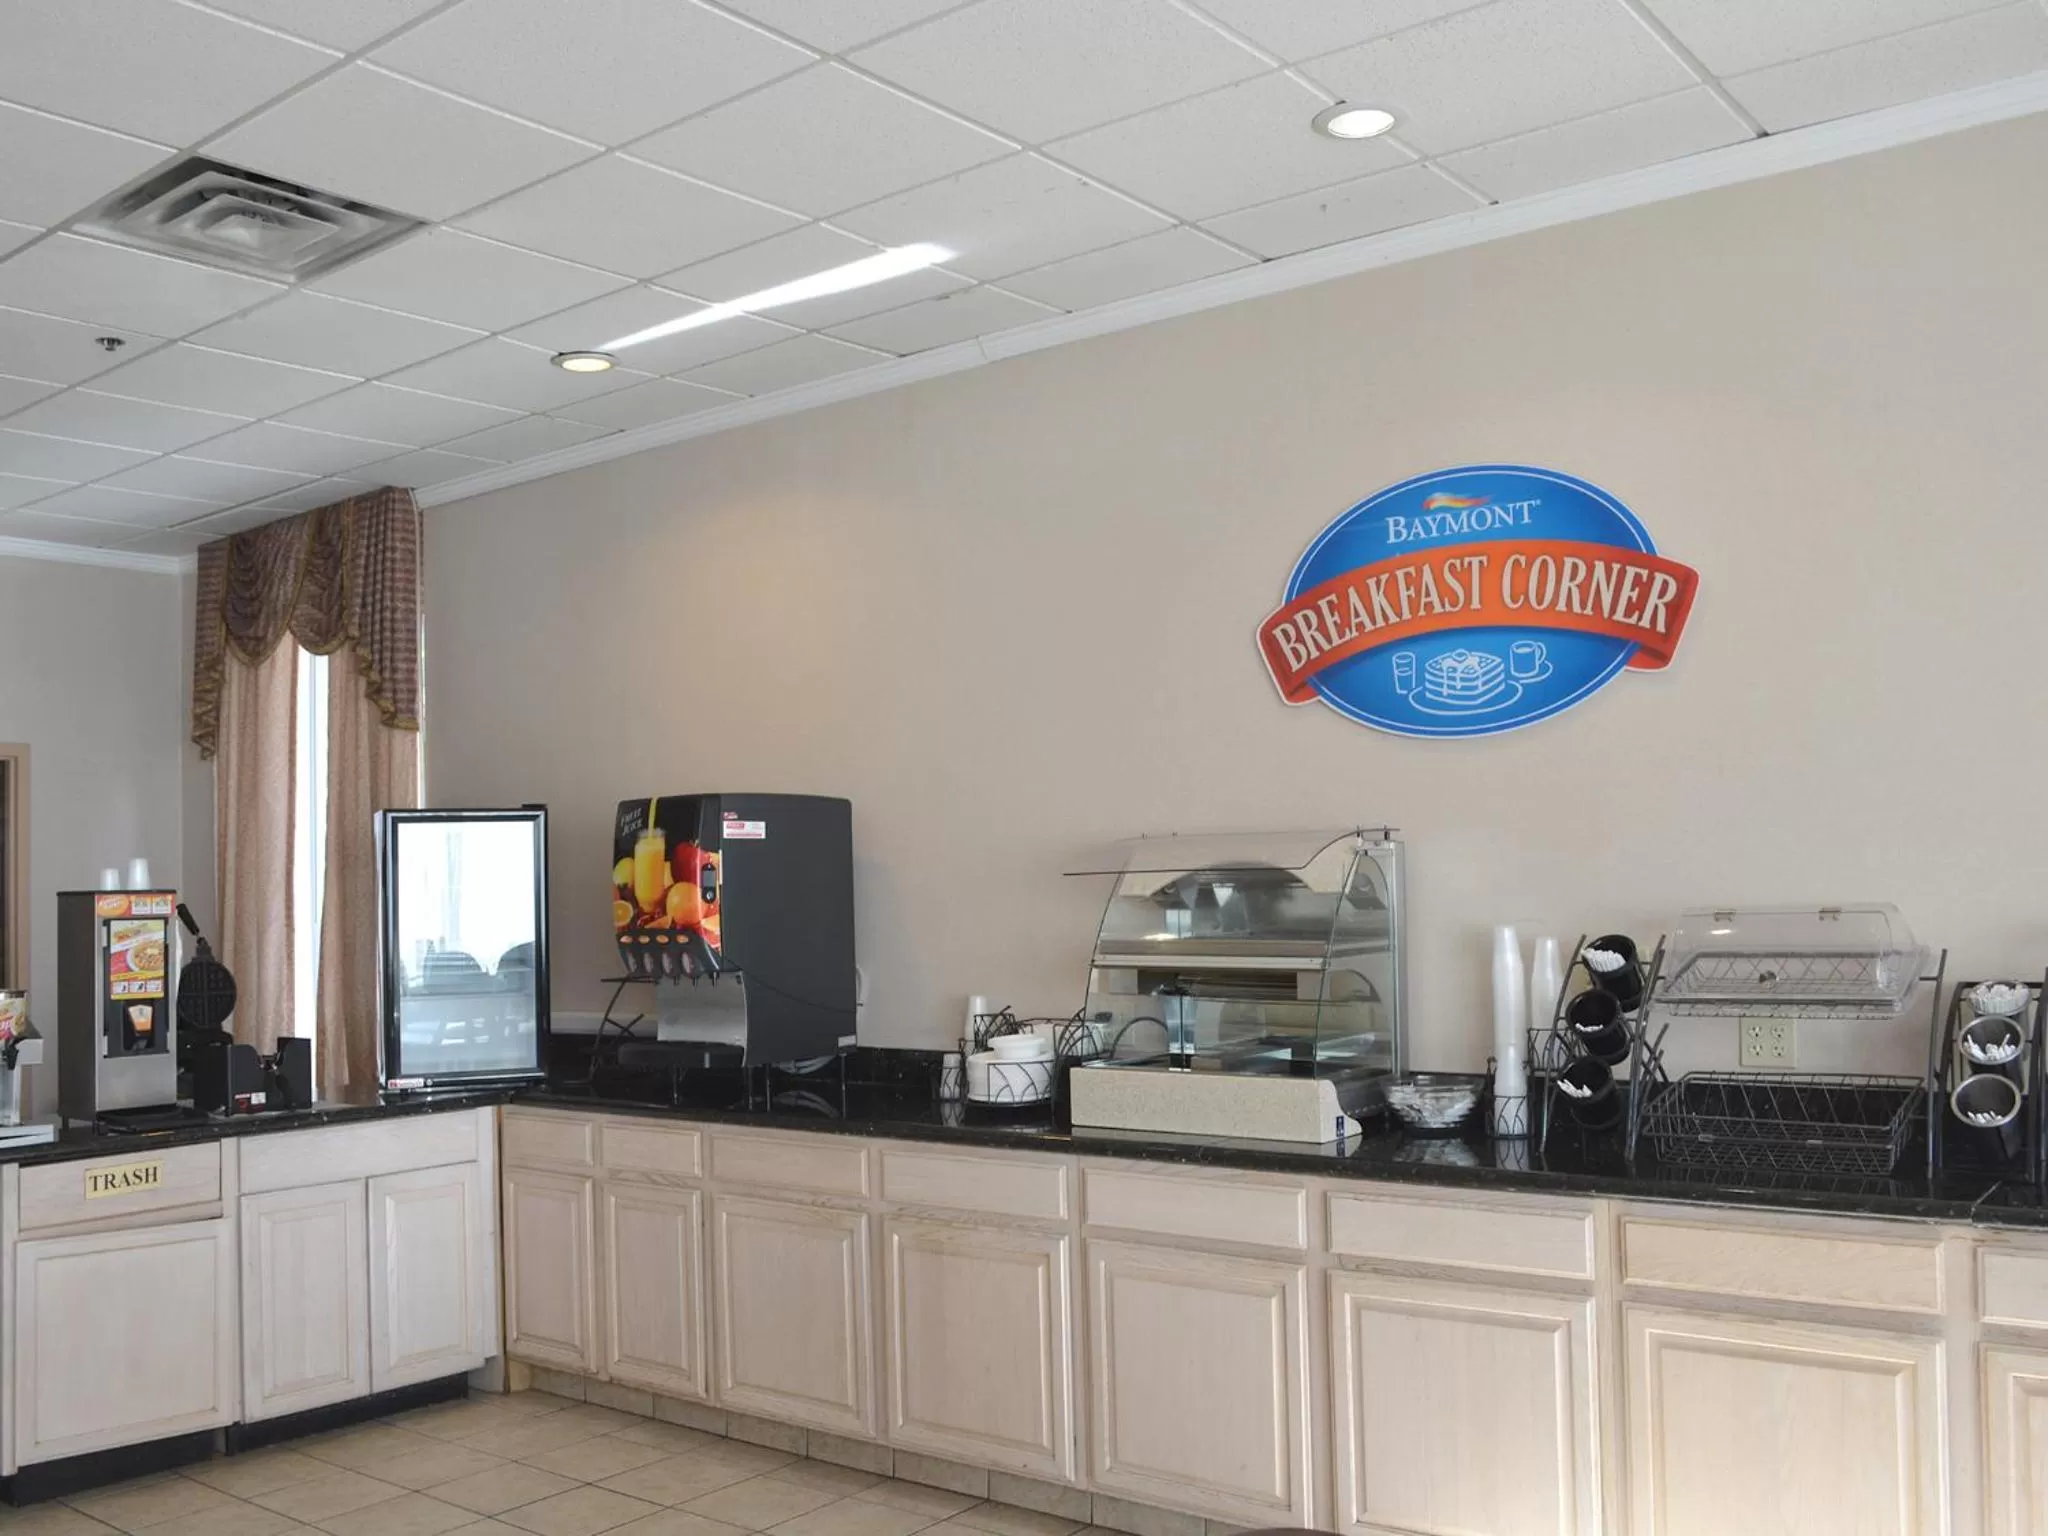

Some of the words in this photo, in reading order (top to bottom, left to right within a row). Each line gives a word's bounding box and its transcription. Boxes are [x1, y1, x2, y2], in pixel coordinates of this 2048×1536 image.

[1387, 500, 1535, 544] BAYMONT
[1272, 554, 1488, 673] BREAKFAST
[1502, 553, 1678, 634] CORNER
[88, 1165, 159, 1193] TRASH
